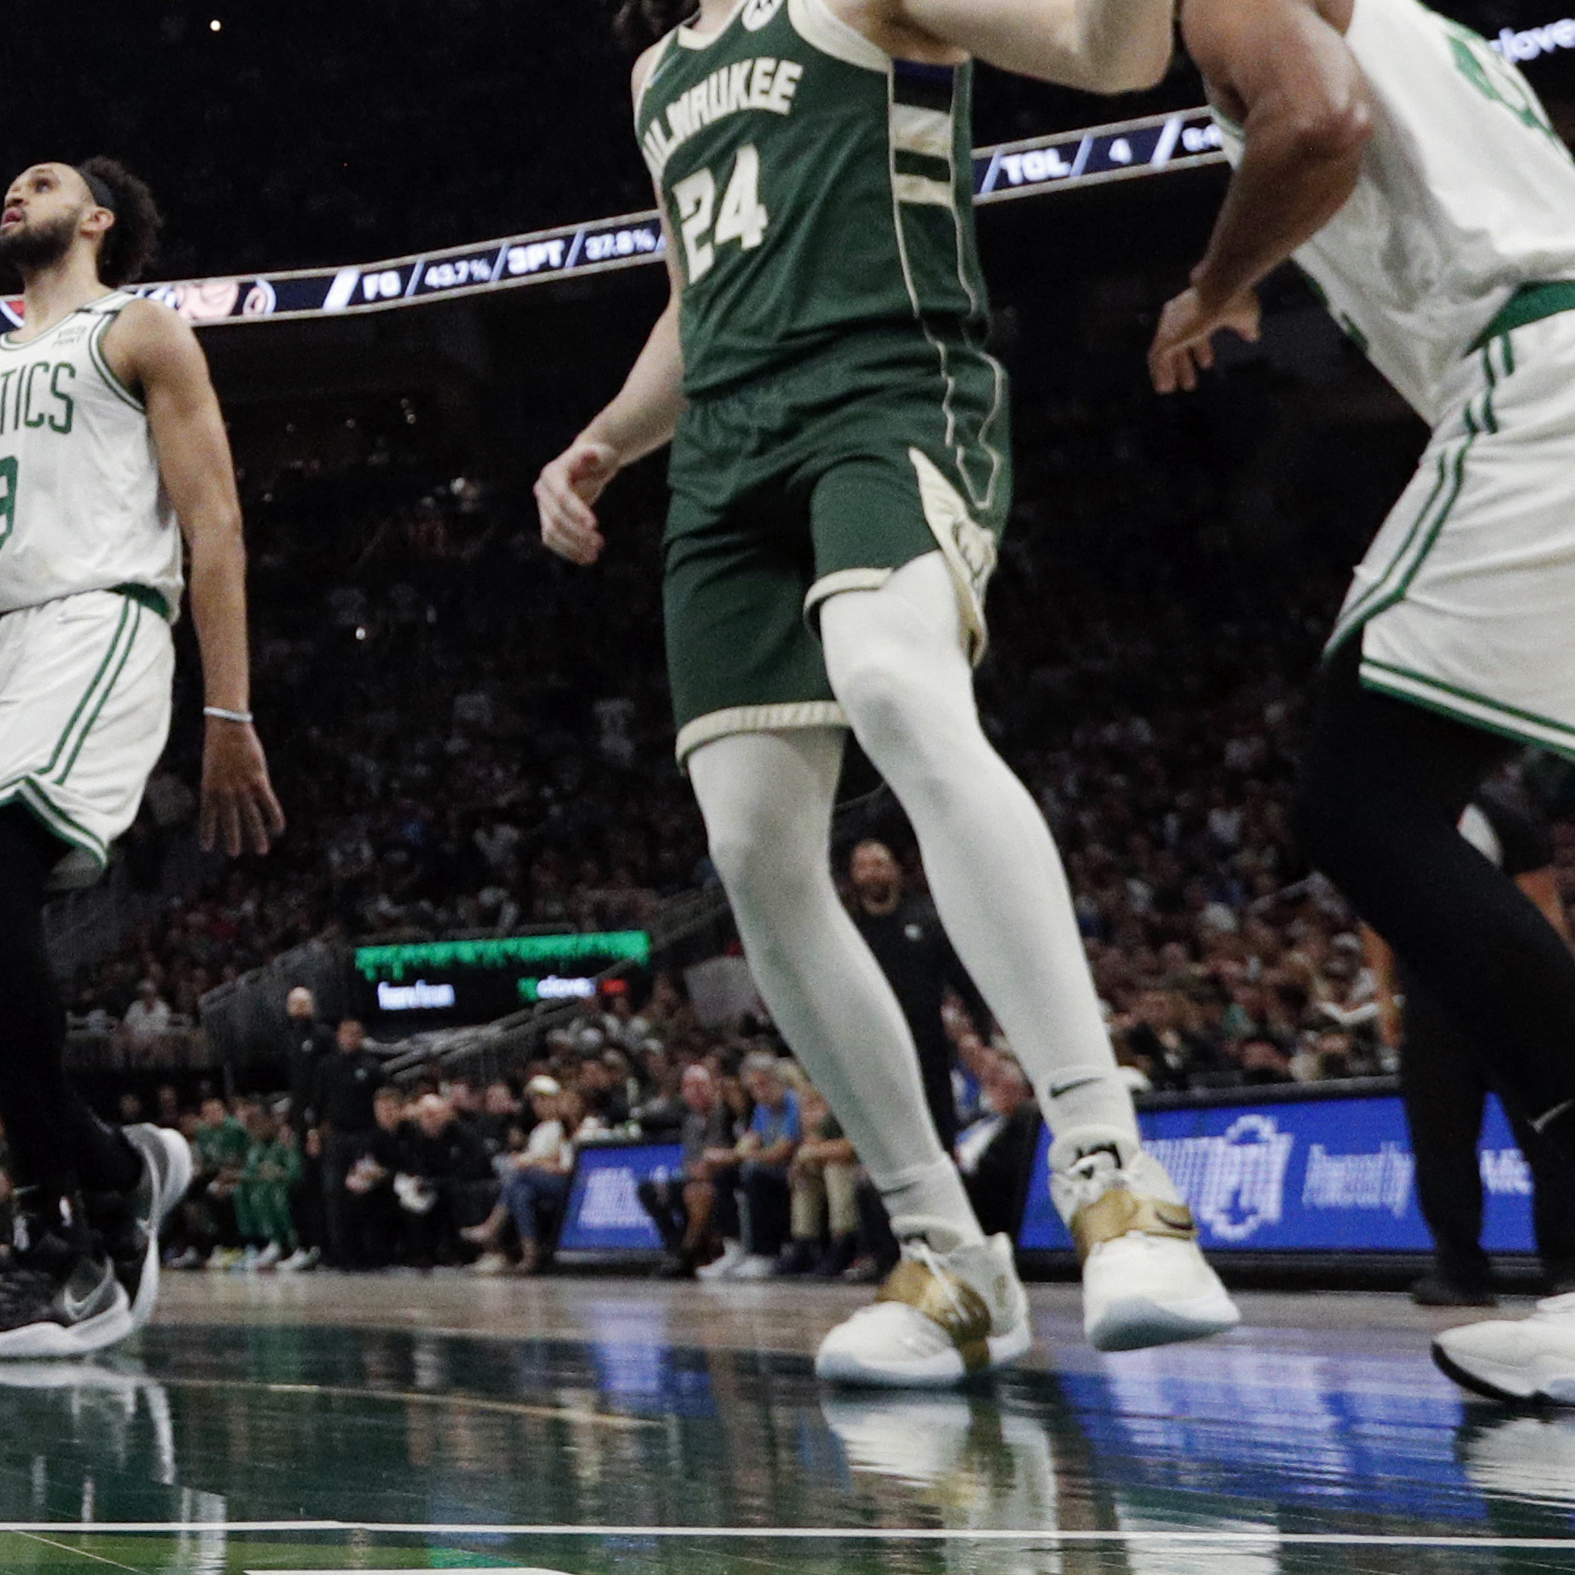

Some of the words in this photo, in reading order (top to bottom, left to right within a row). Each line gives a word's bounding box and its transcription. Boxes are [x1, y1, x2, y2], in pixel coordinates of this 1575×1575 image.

[1000, 148, 1071, 185] TOL
[674, 144, 768, 284] 24
[507, 239, 566, 275] 3PT
